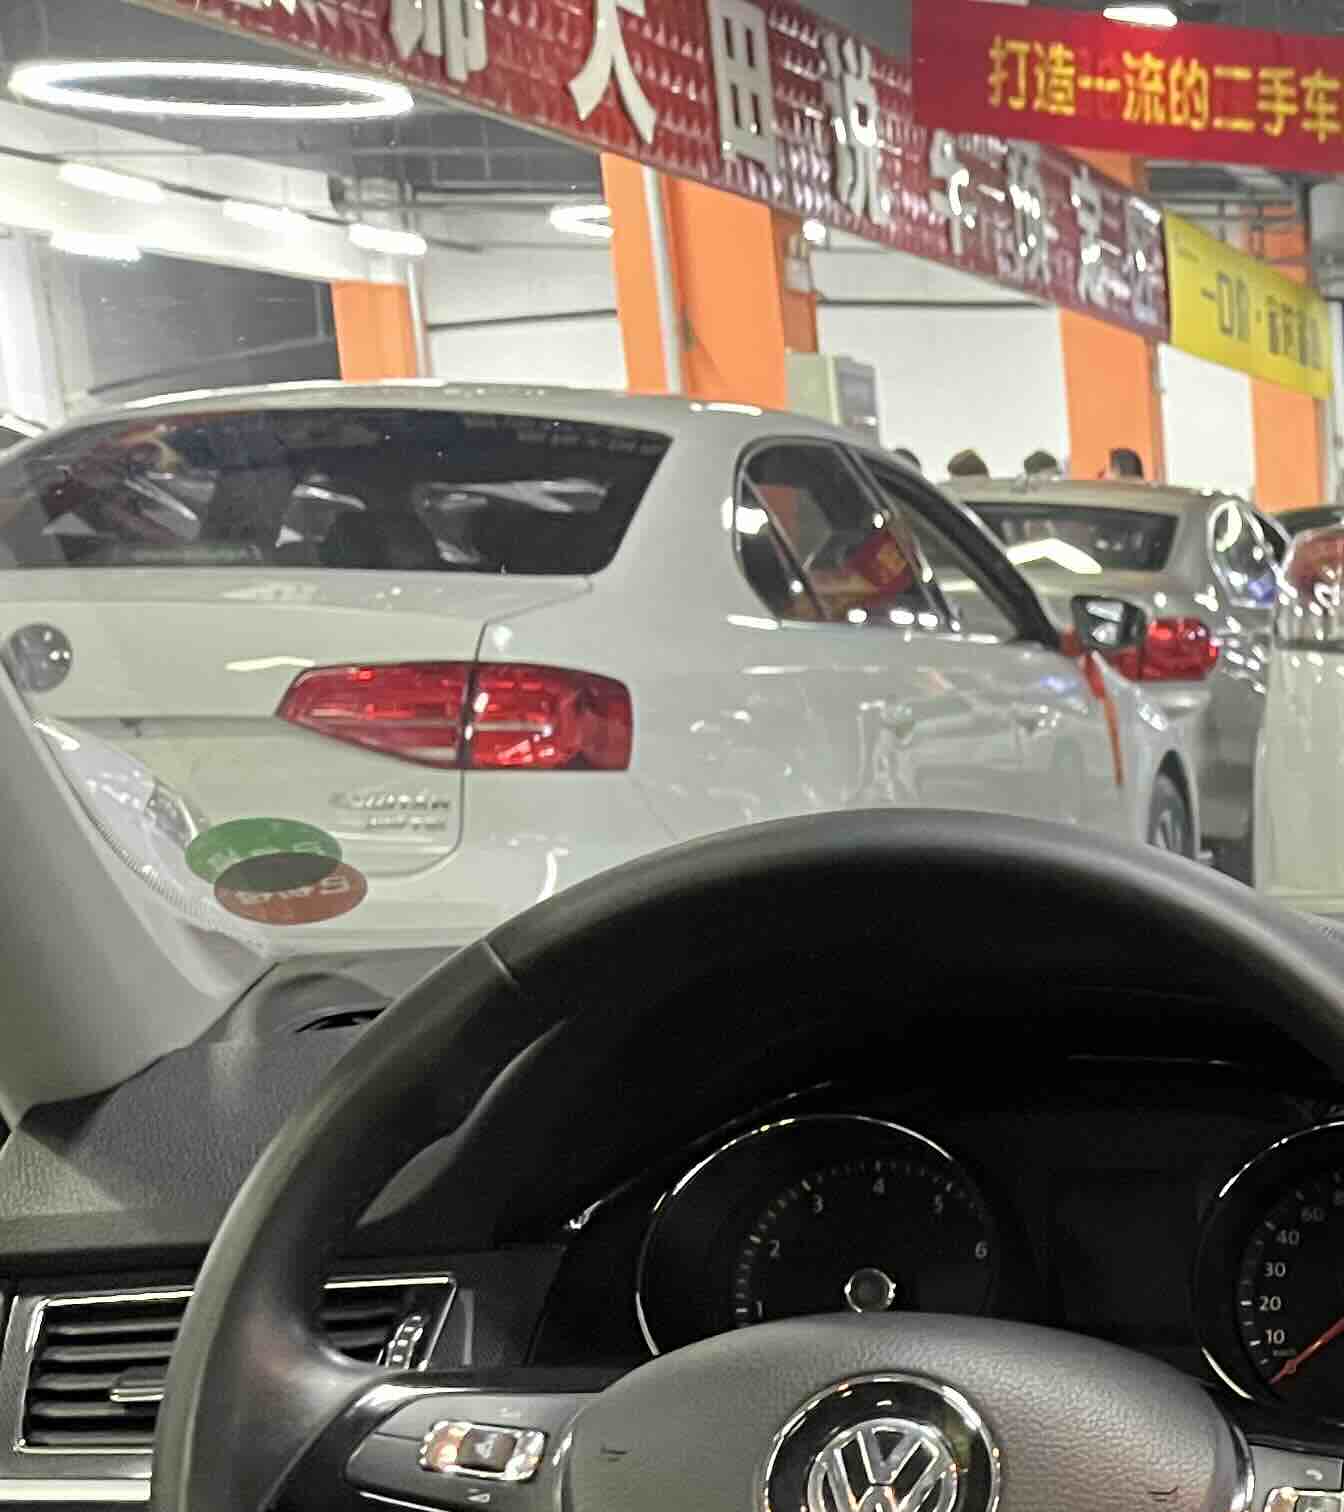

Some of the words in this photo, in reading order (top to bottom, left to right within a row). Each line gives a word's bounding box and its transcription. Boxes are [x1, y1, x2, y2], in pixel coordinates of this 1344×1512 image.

[1277, 1229, 1300, 1246] 40
[1264, 1262, 1287, 1278] 30
[1259, 1296, 1282, 1312] 20
[1265, 1329, 1286, 1344] 10
